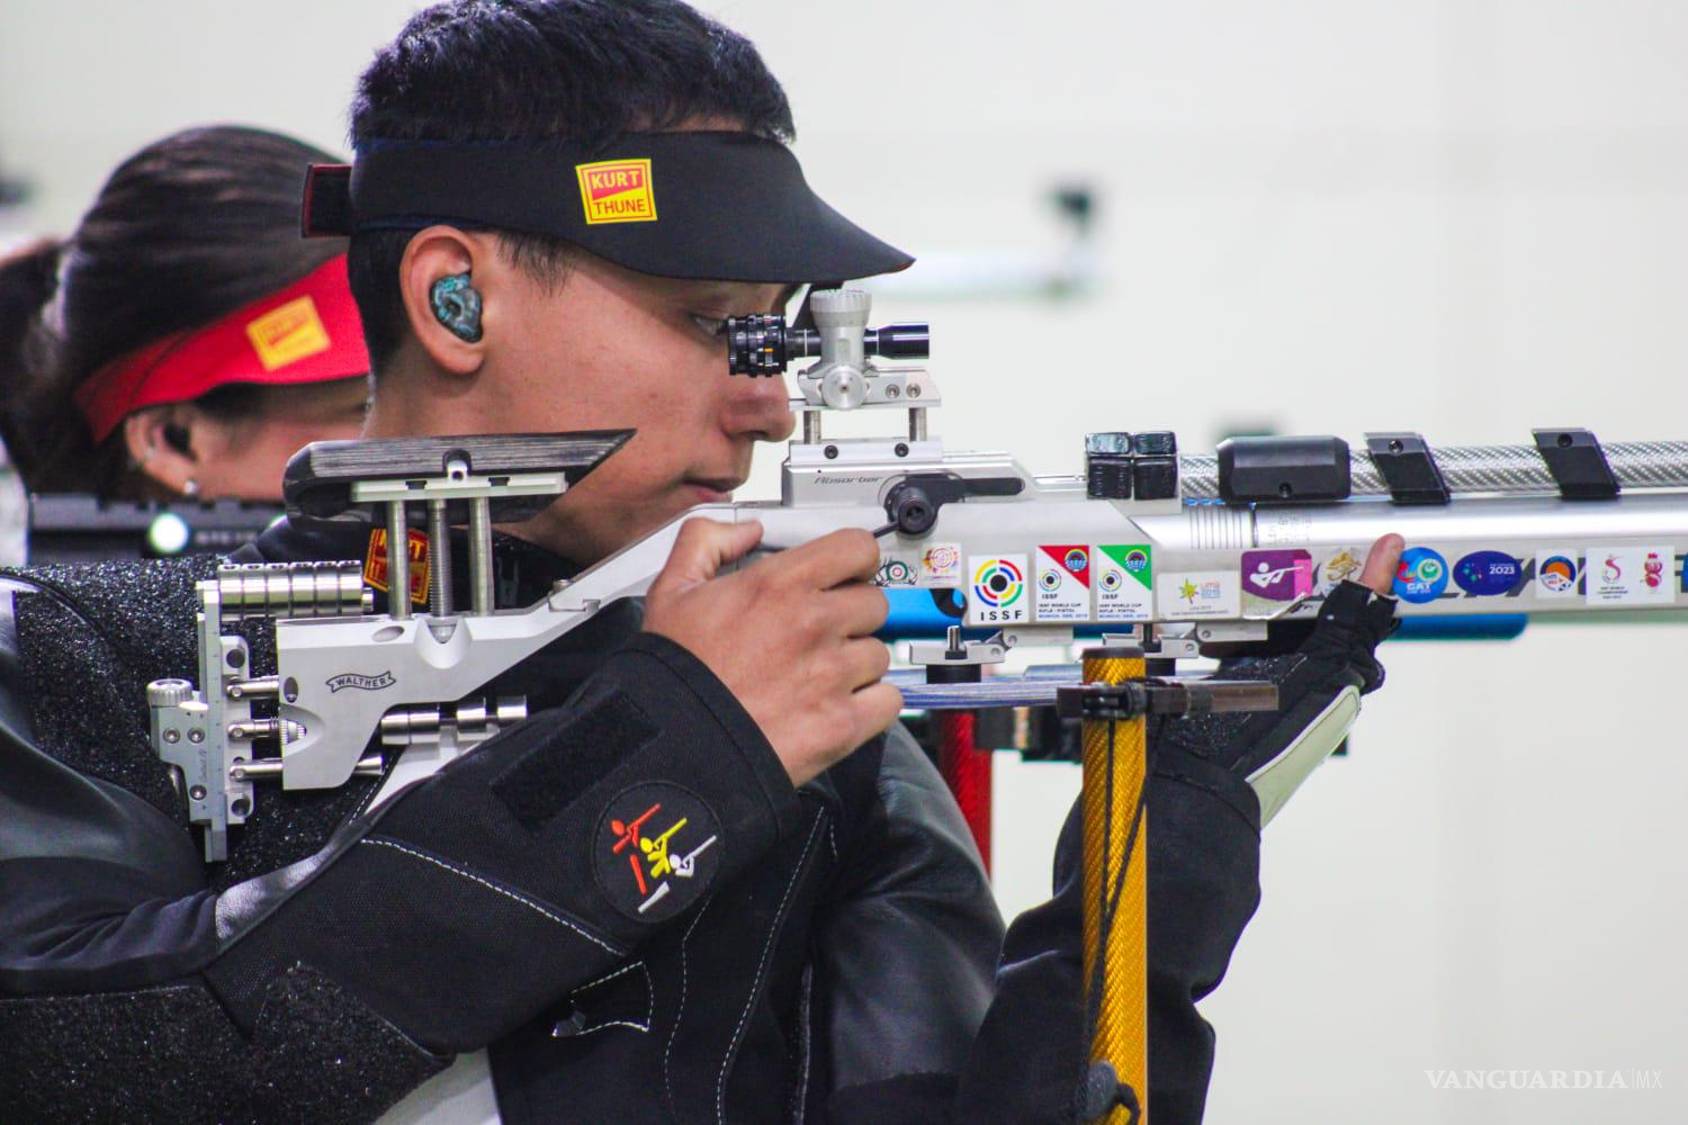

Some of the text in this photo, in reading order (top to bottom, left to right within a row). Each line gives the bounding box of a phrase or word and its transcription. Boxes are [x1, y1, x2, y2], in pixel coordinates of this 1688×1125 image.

[591, 170, 641, 189] KURT
[592, 199, 646, 215] THUNE
[1489, 566, 1515, 575] 2023
[980, 610, 1022, 621] ISSF
[336, 677, 386, 688] WALTHER
